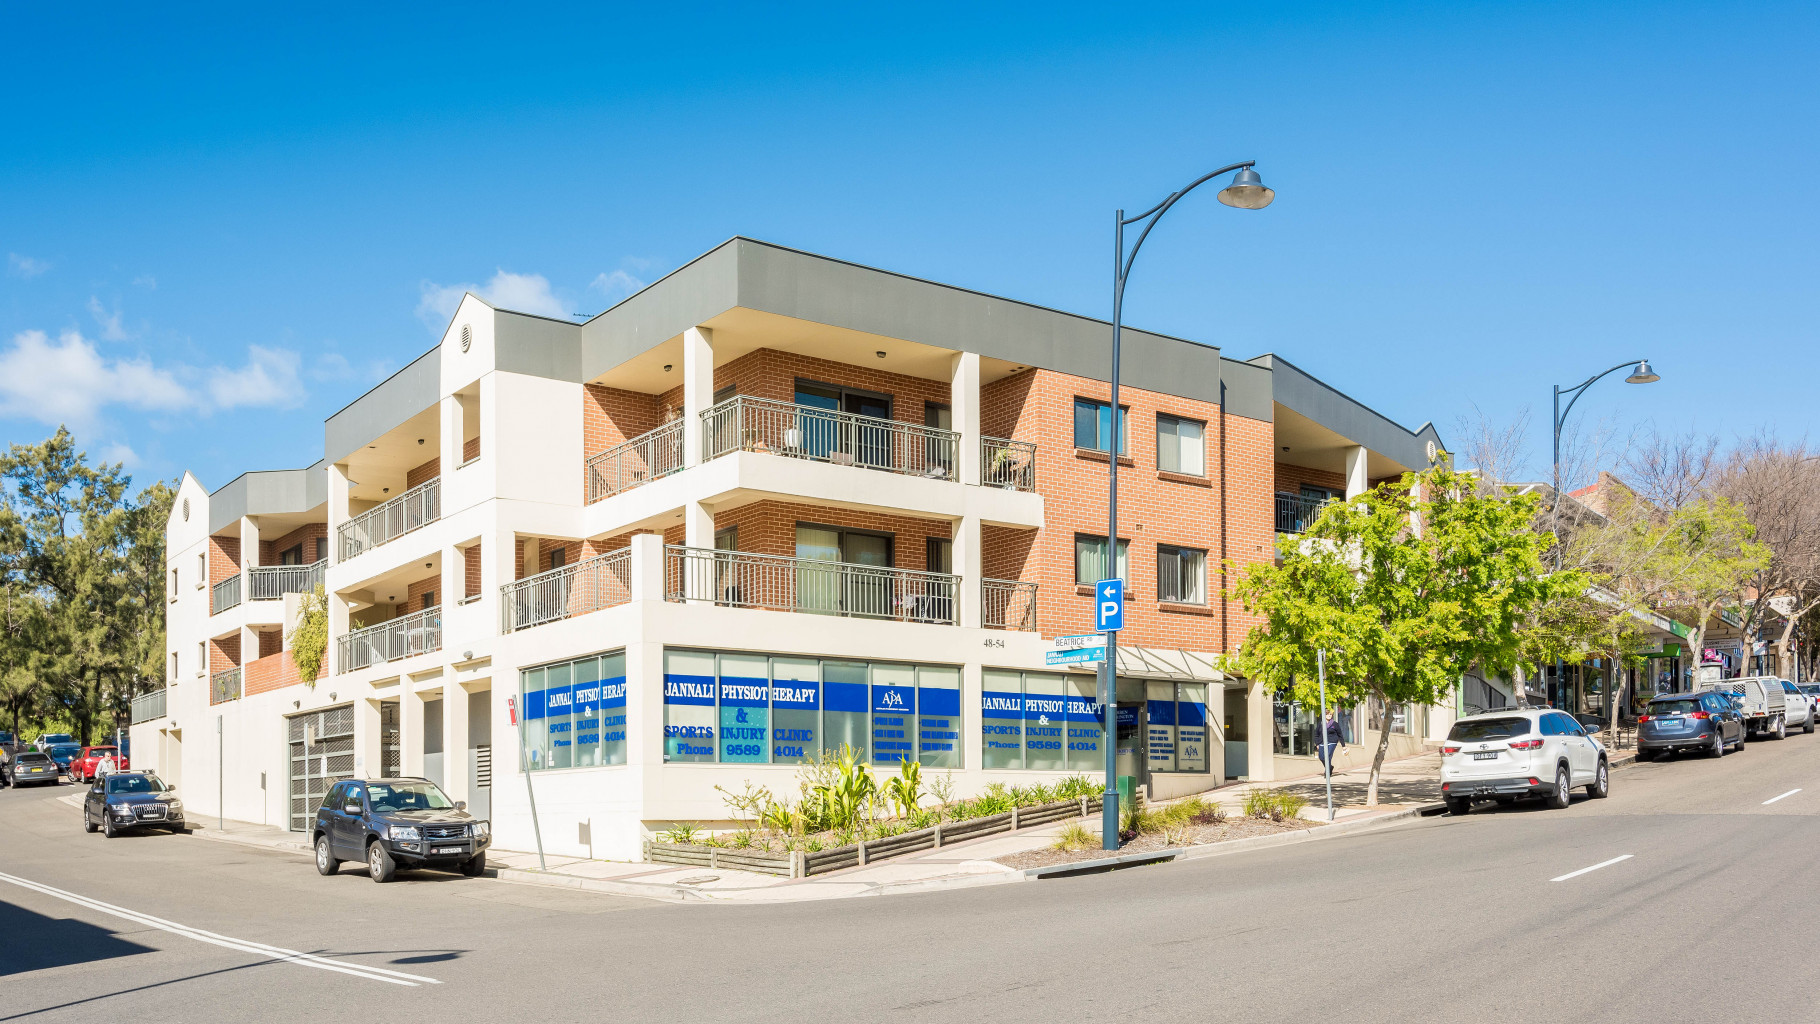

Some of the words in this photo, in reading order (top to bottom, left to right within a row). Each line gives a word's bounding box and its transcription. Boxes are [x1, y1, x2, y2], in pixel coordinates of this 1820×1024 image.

[1101, 601, 1119, 626] P
[983, 638, 1005, 648] 48-54
[1055, 637, 1085, 647] BEATRICE
[664, 682, 714, 698] JANNALI
[549, 692, 571, 708] JANNAL
[982, 697, 1021, 711] JANNALI
[584, 705, 592, 717] &
[735, 708, 748, 723] &
[1038, 715, 1049, 725] &
[577, 734, 599, 744] 9589
[604, 731, 625, 742] 4014
[664, 725, 713, 738] SPORTS
[720, 727, 766, 740] INJURY
[774, 729, 813, 741] CLINIC
[982, 726, 1021, 735] SPORTS
[1026, 727, 1062, 736] INJURY
[1068, 729, 1101, 738] CLINIC
[677, 743, 713, 755] Phone
[726, 744, 760, 756] 9589
[774, 746, 803, 757] 4014
[988, 741, 1020, 749] Phone
[1027, 741, 1061, 749] 9589
[1068, 742, 1097, 750] 4014
